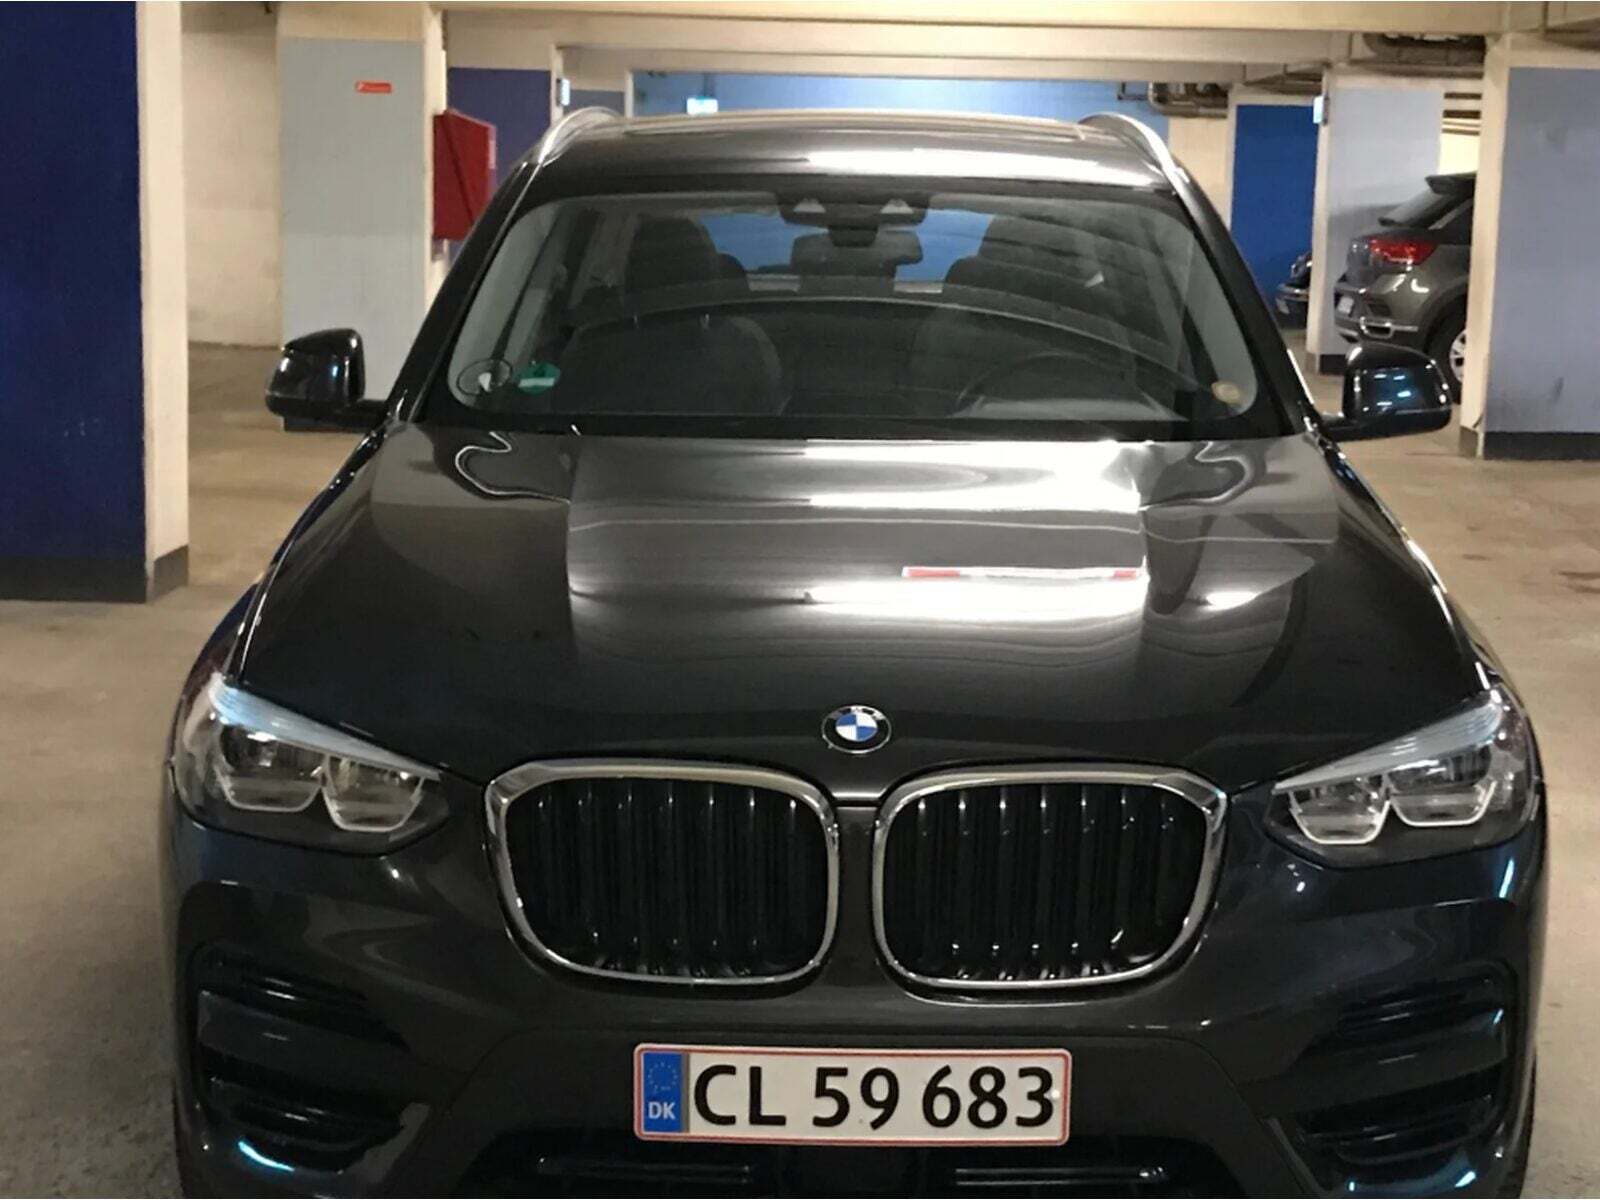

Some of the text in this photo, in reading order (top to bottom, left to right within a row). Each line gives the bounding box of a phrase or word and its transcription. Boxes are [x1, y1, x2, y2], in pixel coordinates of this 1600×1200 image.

[648, 1101, 676, 1120] DK
[693, 1064, 1054, 1131] CL 59 683
